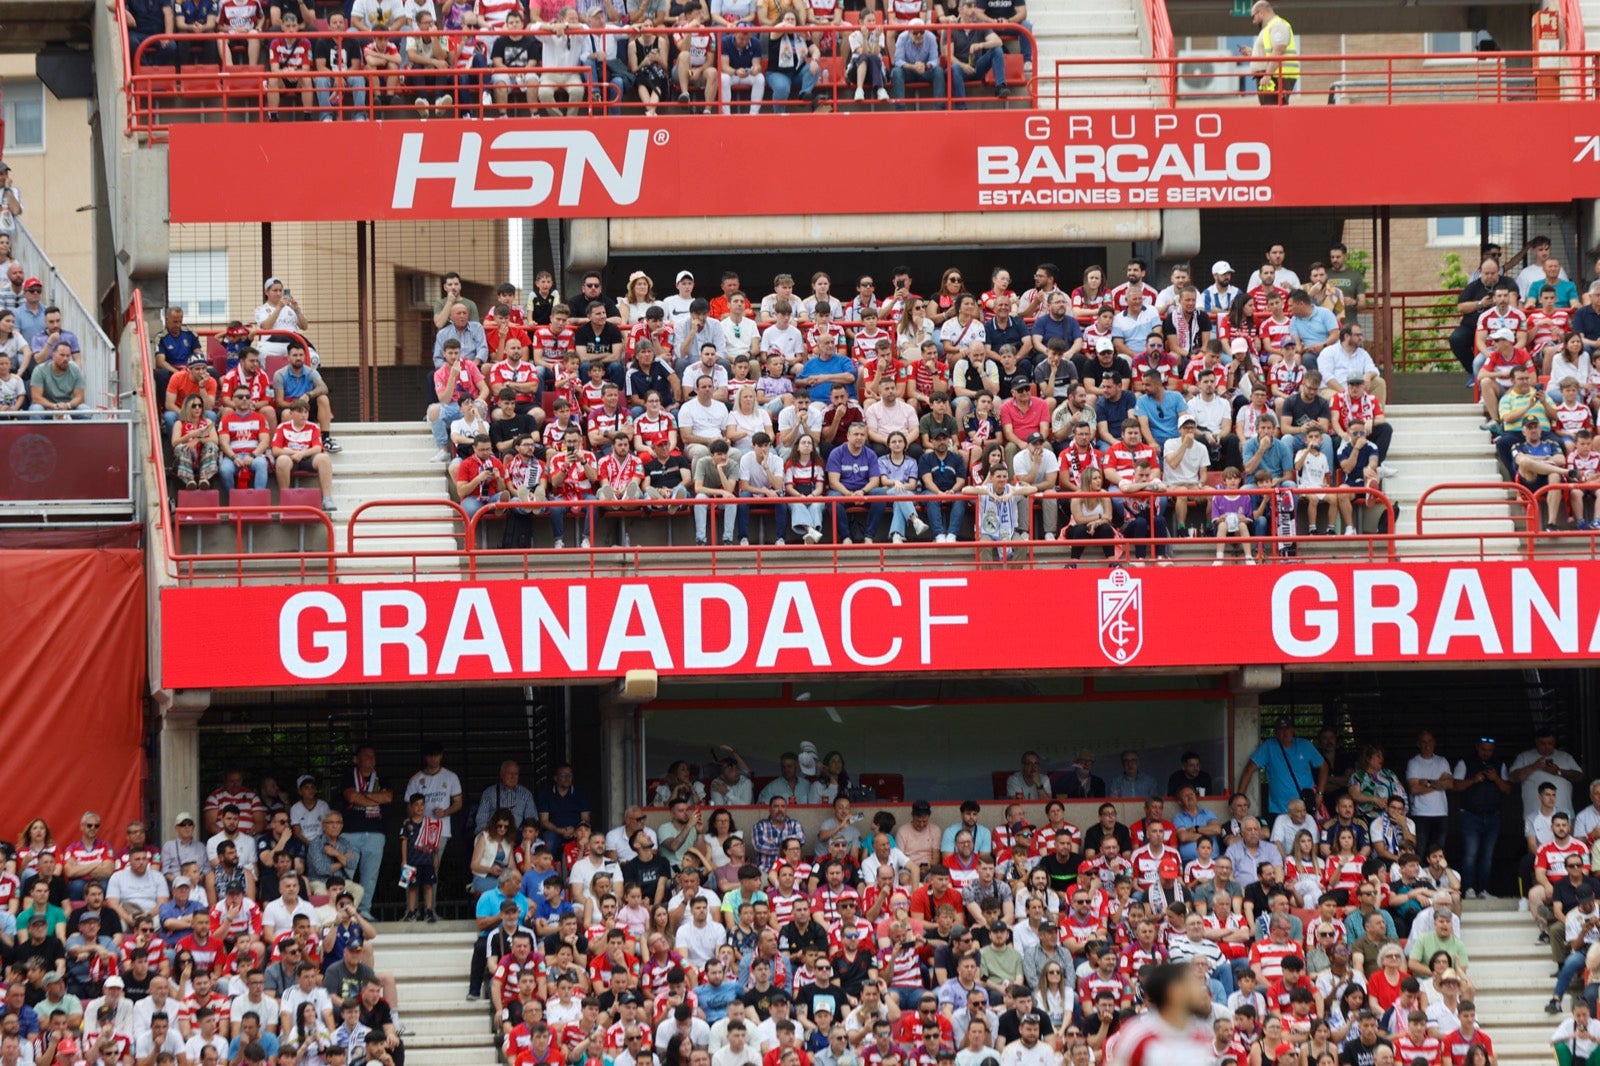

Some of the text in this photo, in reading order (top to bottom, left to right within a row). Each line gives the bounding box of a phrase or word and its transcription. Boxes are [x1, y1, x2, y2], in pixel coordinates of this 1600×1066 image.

[1024, 113, 1222, 140] GRUPO
[391, 129, 650, 209] HSN
[977, 141, 1272, 186] BARCALO
[978, 186, 1272, 206] ESTACIONES DE SERVICIO
[1271, 567, 1600, 658] GRAN
